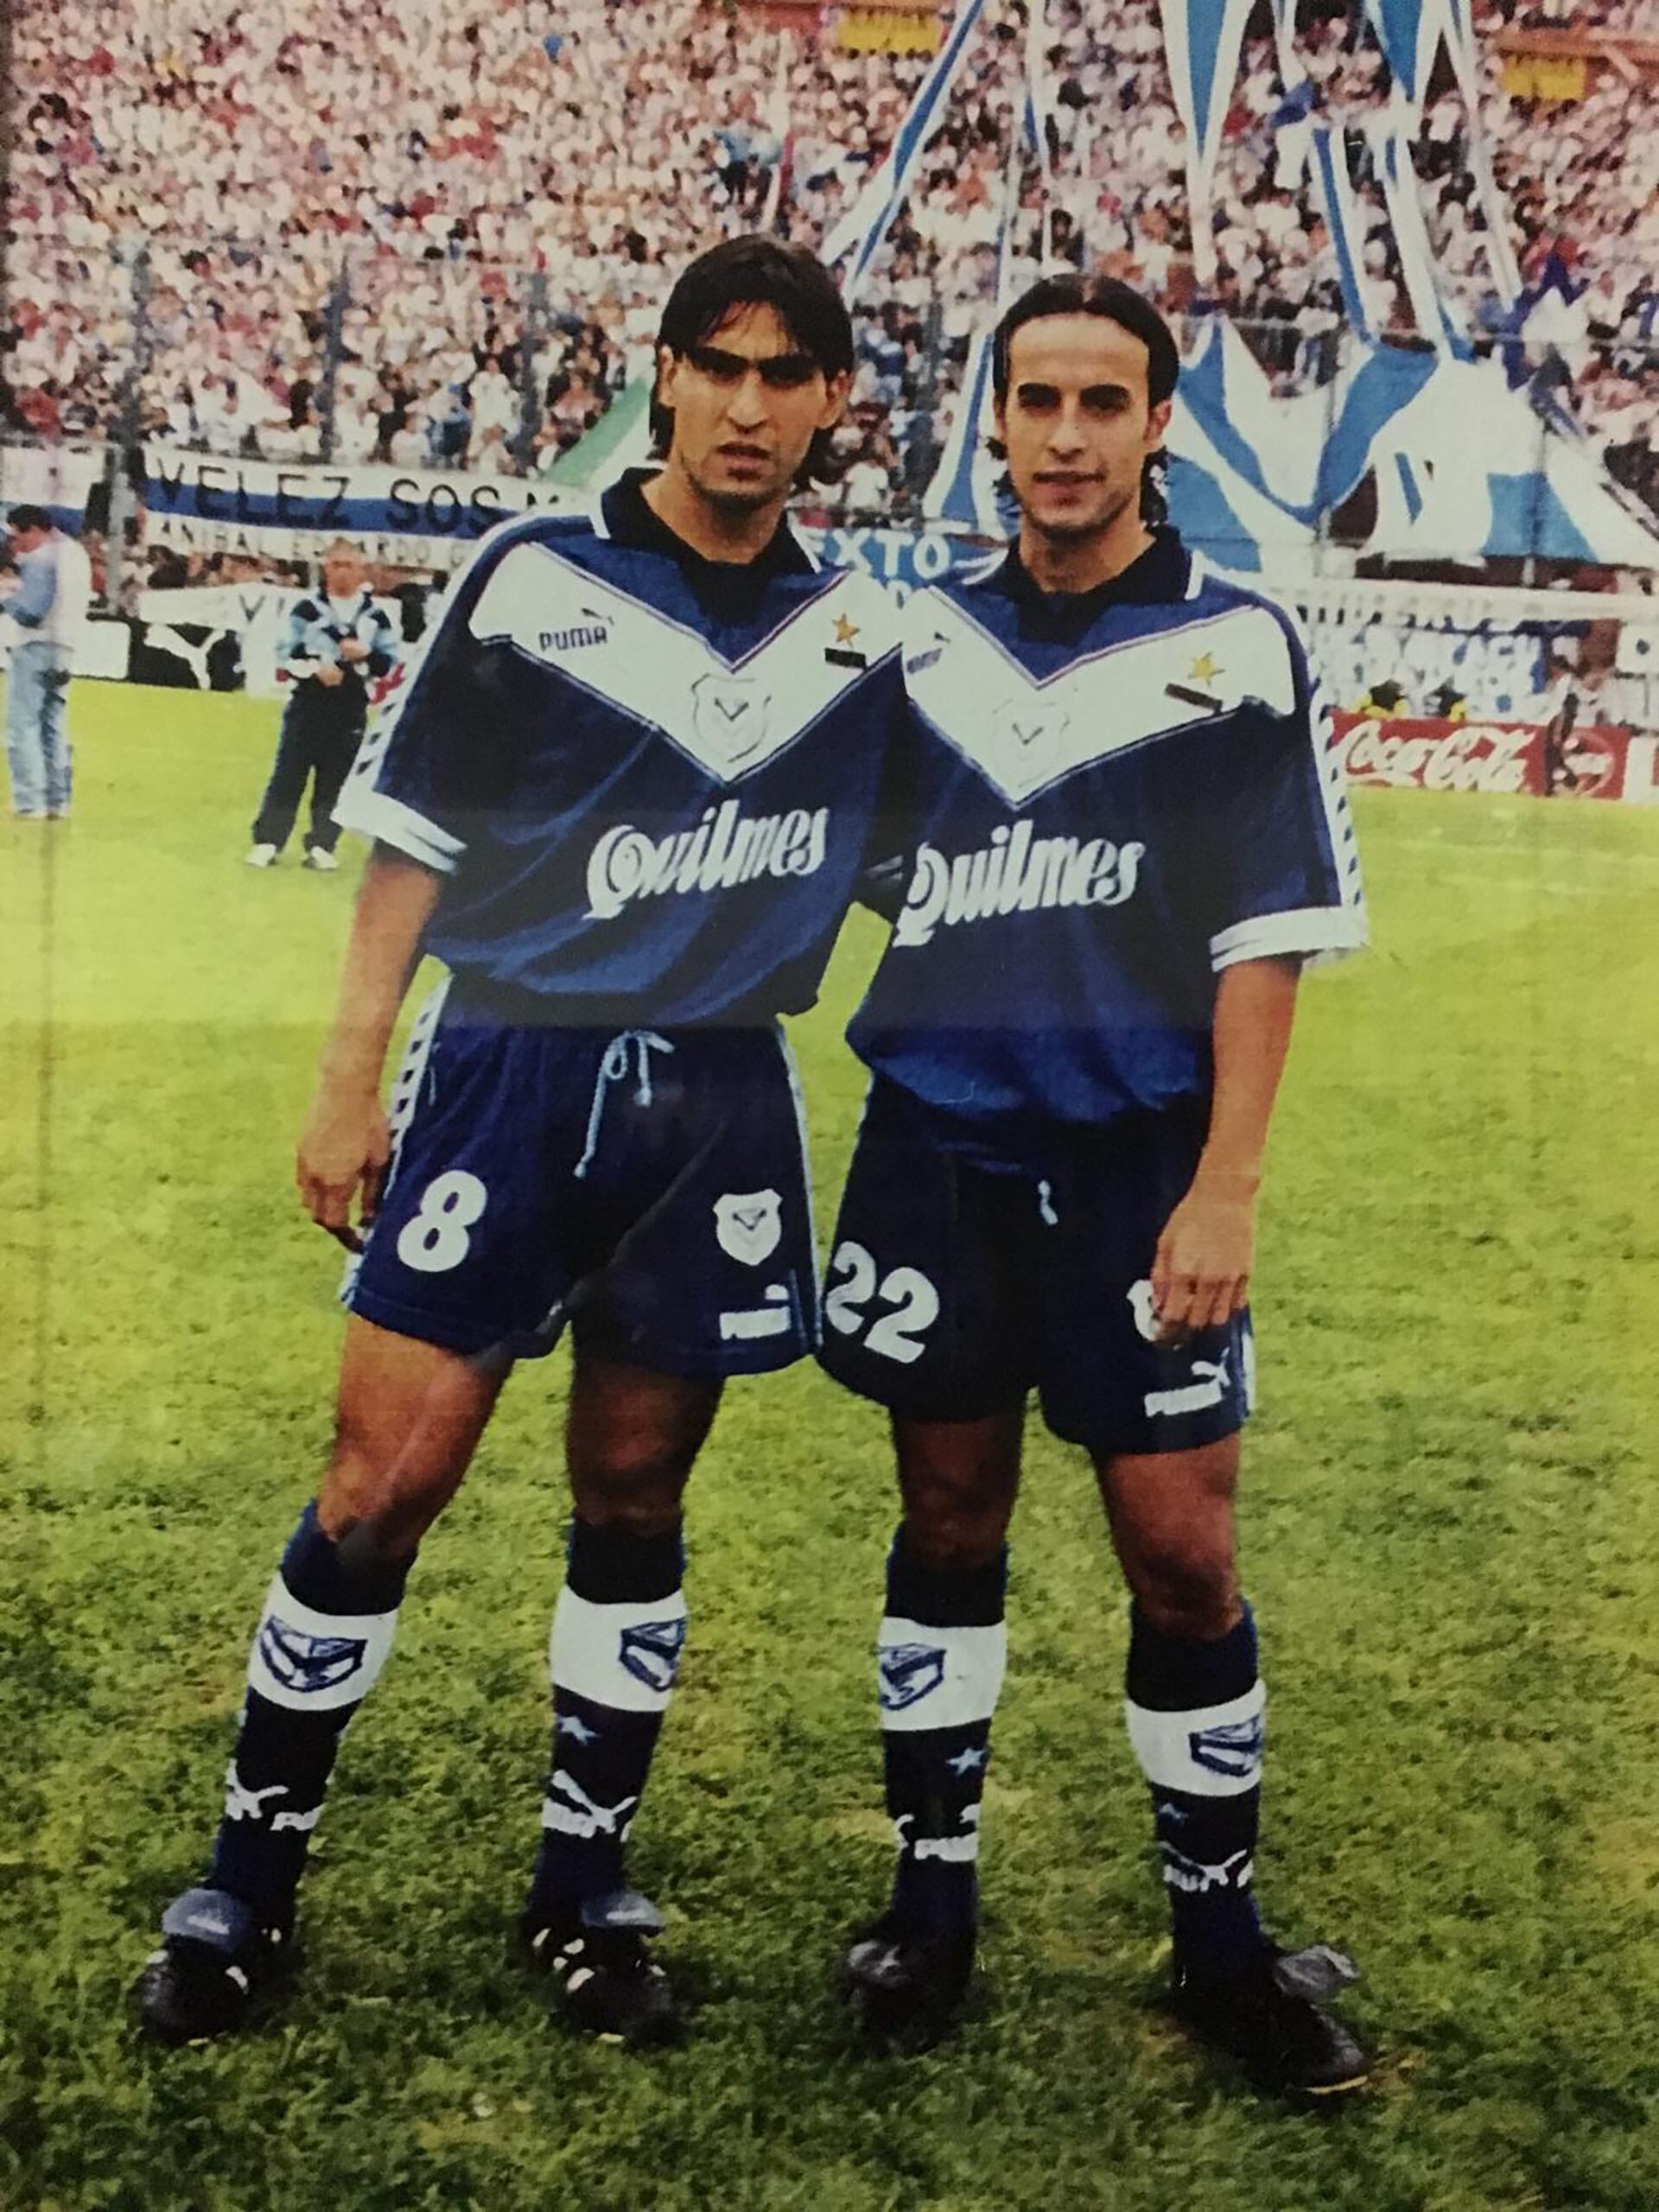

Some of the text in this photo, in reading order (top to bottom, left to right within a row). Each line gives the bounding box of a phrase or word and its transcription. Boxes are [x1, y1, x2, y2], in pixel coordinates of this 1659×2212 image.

[156, 457, 350, 529] VELEZ
[538, 625, 608, 652] PUMA
[582, 799, 829, 921] Quilmes
[397, 1169, 487, 1273] 8
[825, 1241, 940, 1364] 22
